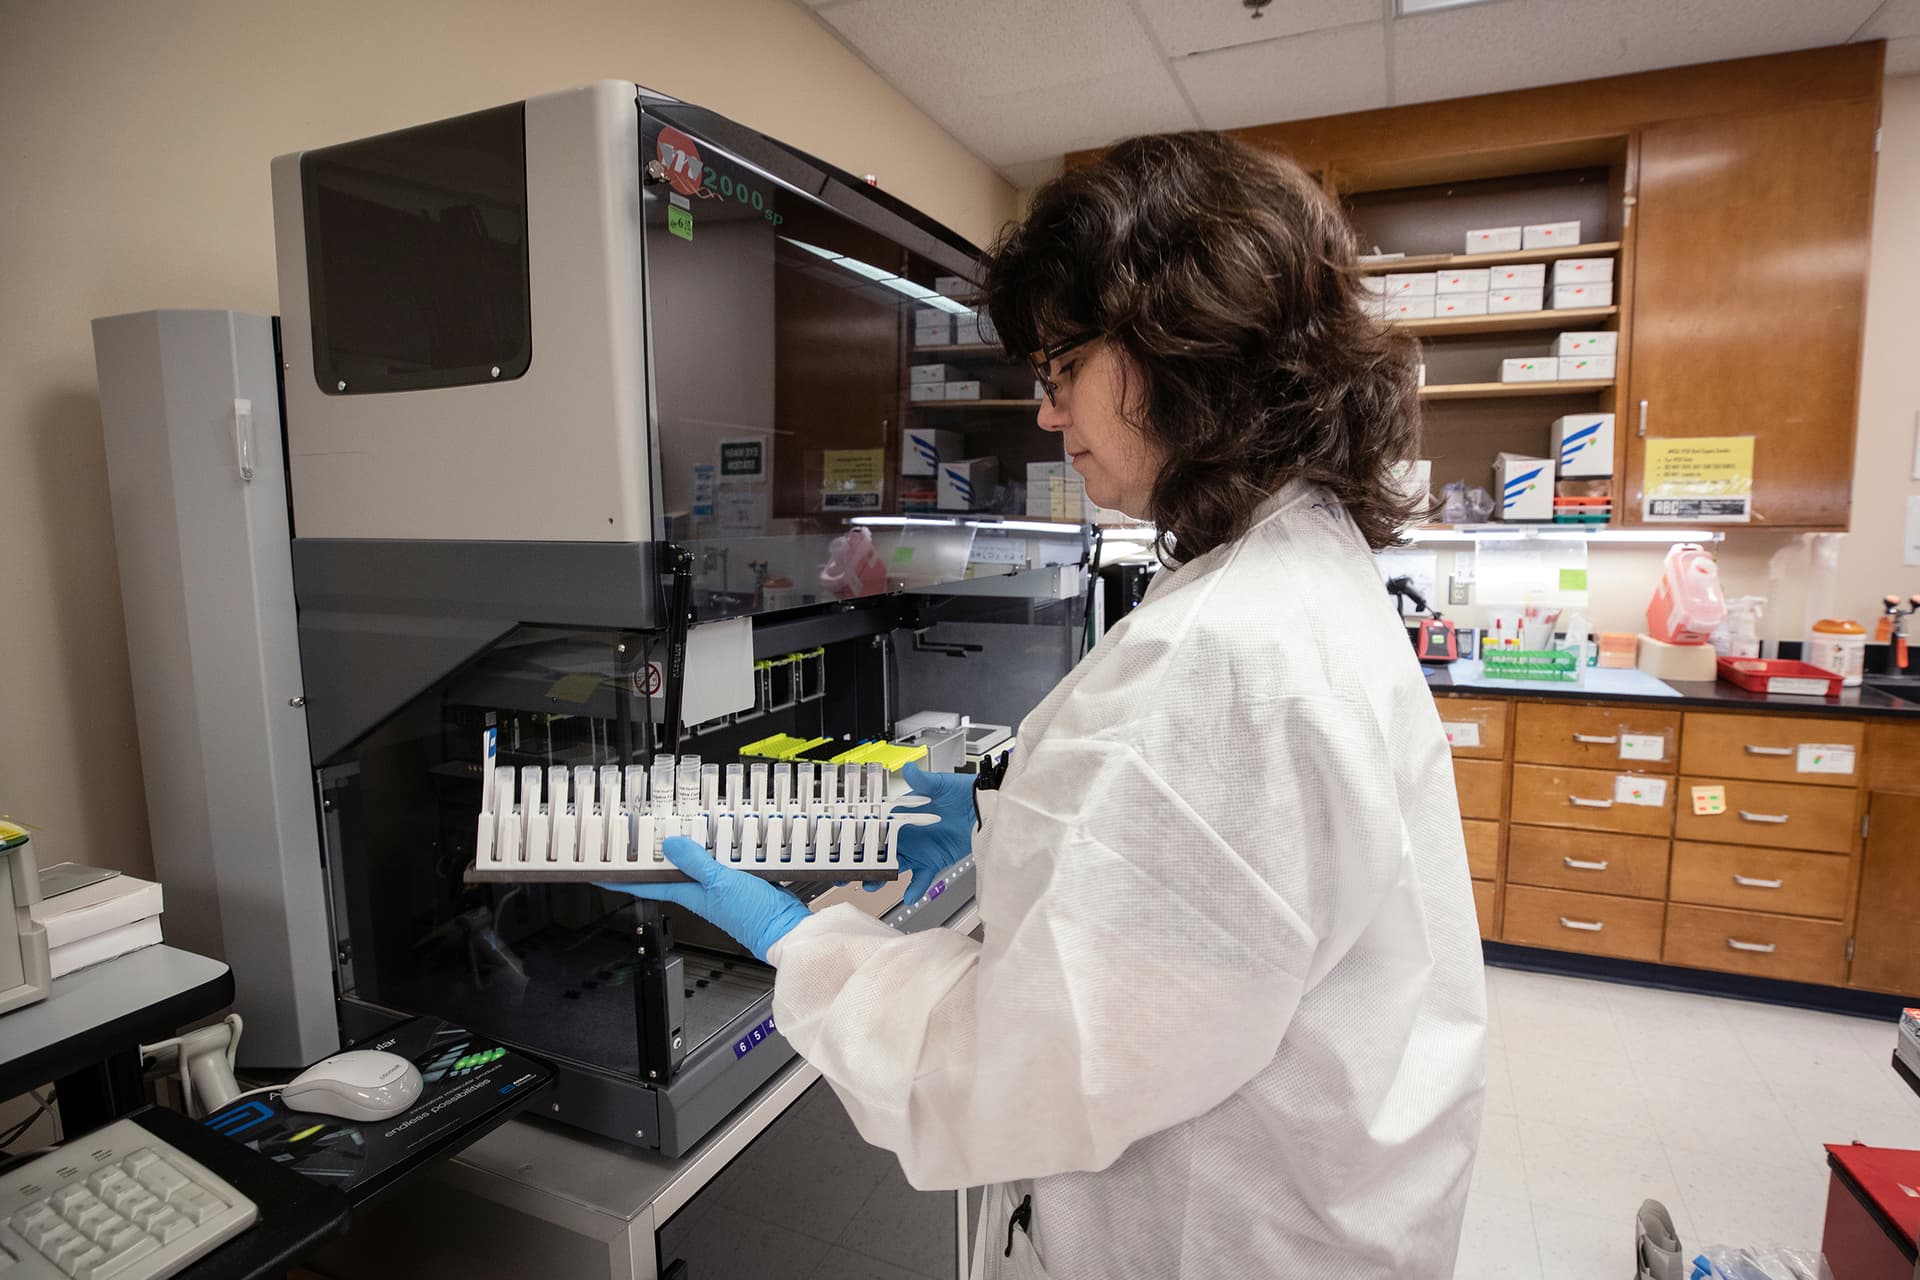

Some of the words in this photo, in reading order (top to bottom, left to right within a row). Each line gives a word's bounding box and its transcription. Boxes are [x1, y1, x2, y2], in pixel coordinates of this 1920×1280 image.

[739, 1041, 747, 1053] 6
[753, 1030, 761, 1041] 5
[385, 1111, 431, 1138] endless
[430, 1077, 492, 1114] possibilities
